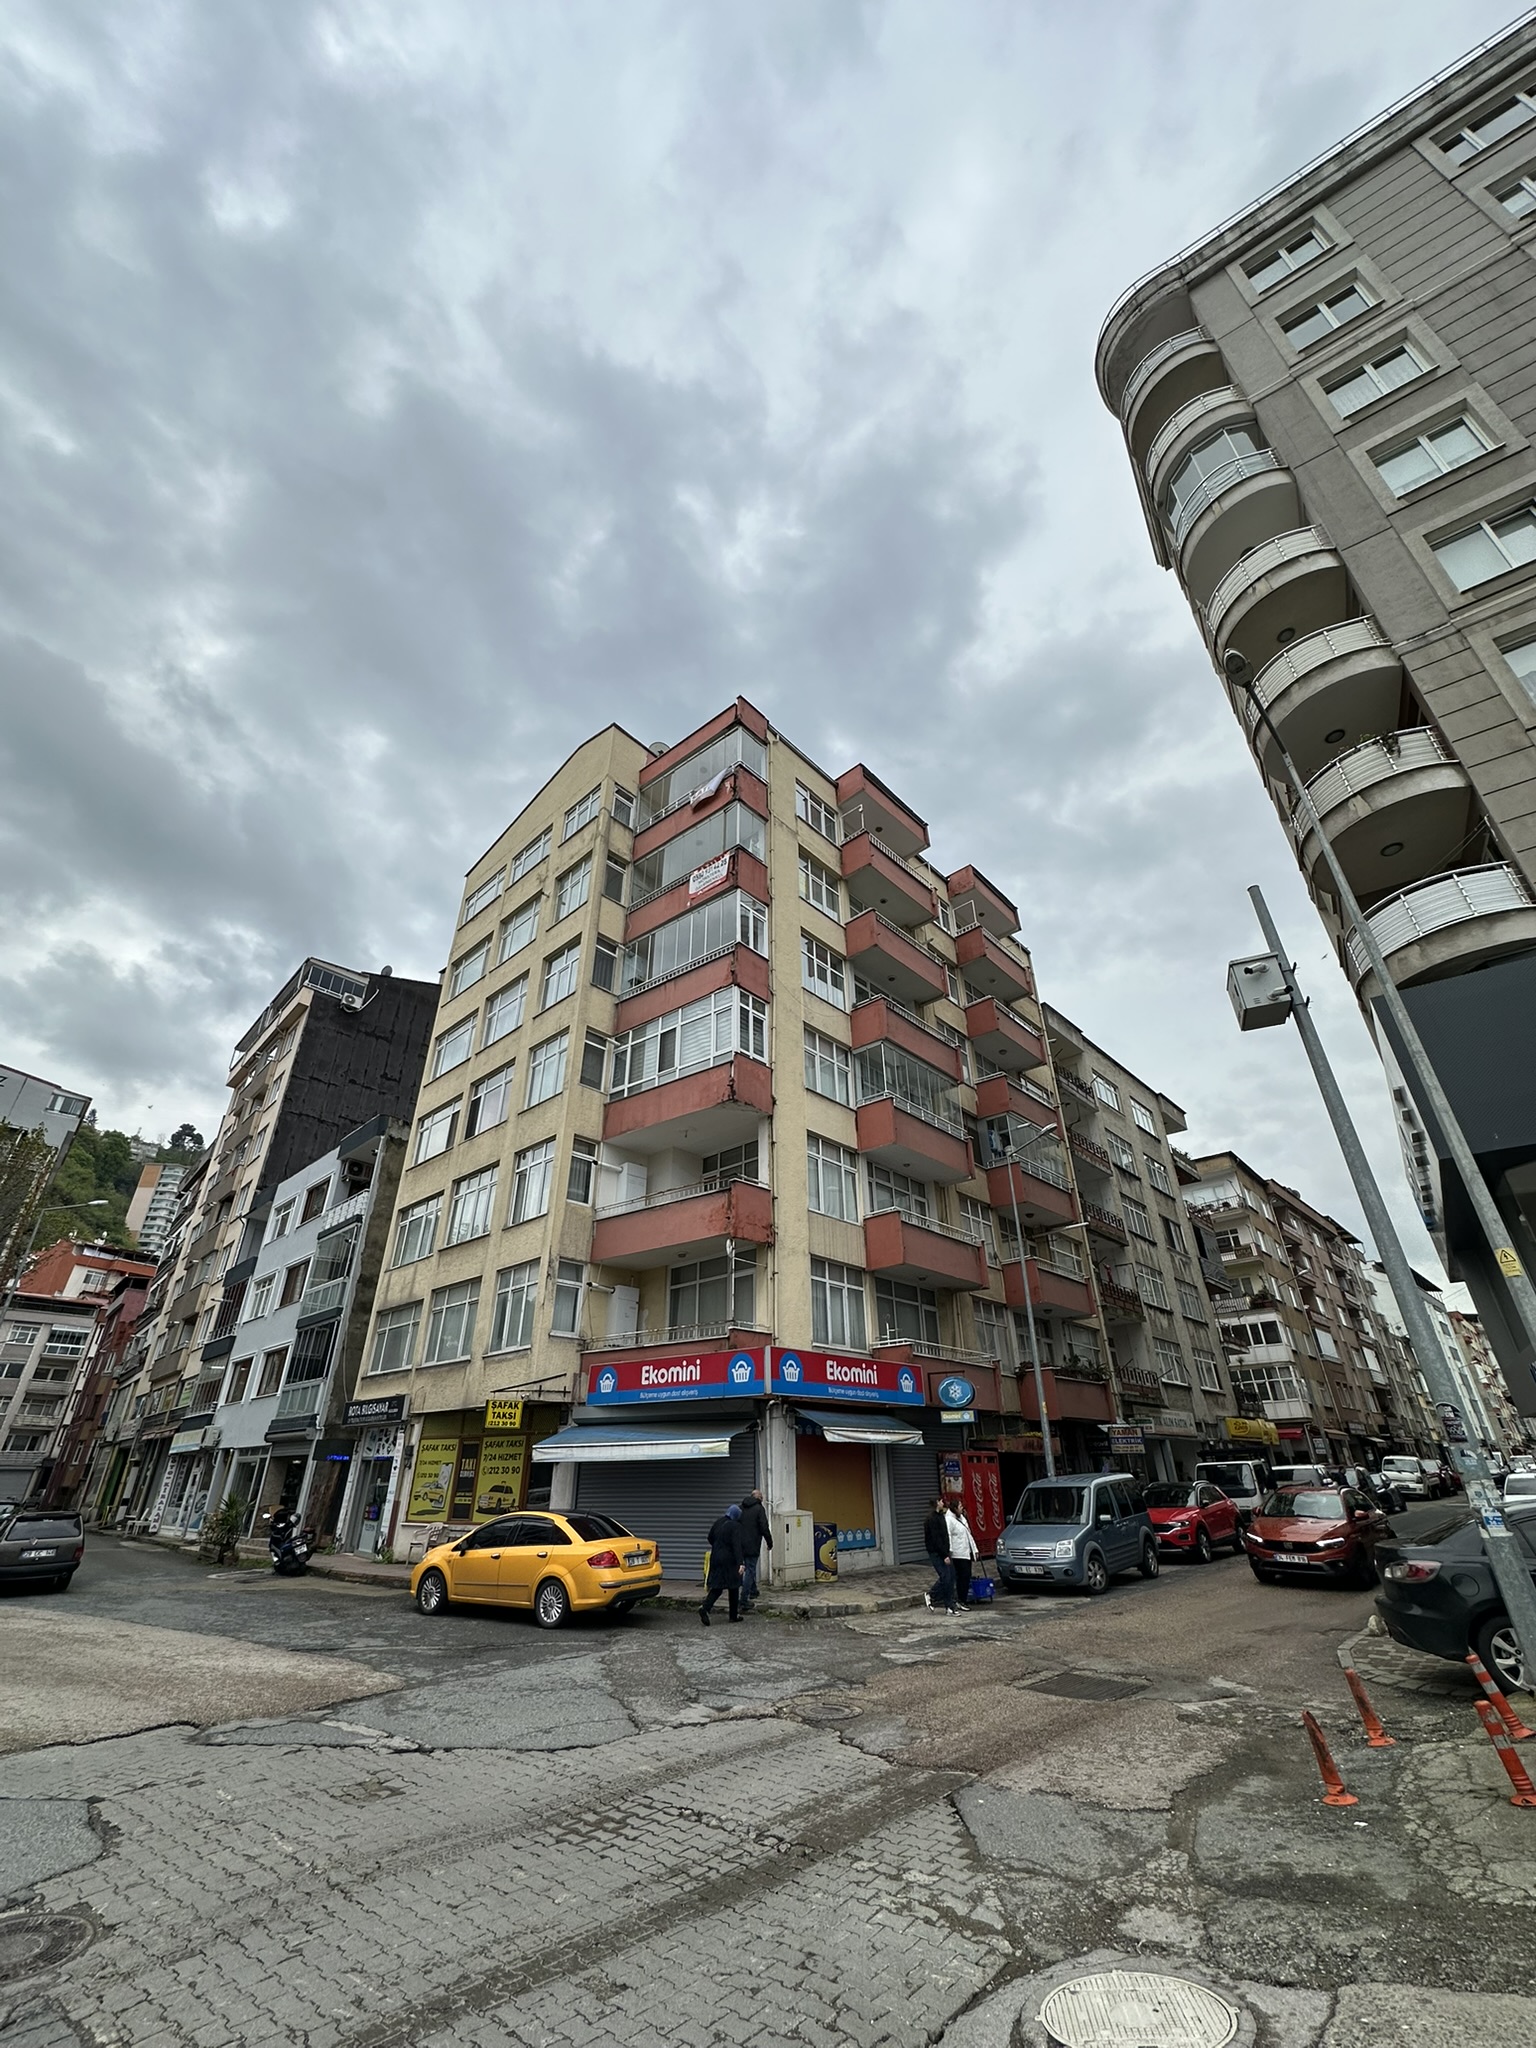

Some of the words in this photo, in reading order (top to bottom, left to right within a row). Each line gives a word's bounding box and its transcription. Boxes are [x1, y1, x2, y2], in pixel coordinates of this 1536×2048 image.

[641, 1359, 701, 1385] Ekomini
[826, 1360, 878, 1385] Ekomini
[491, 1401, 520, 1411] ŞAFAK
[421, 1444, 440, 1454] ŞAFAK
[484, 1440, 505, 1450] ŞAFAK
[483, 1453, 497, 1462] 7/24
[489, 1466, 500, 1474] 212
[501, 1466, 510, 1474] 30
[511, 1466, 520, 1474] 90
[972, 1469, 986, 1531] Coca-Cola
[988, 1470, 1002, 1530] Coca-Cola
